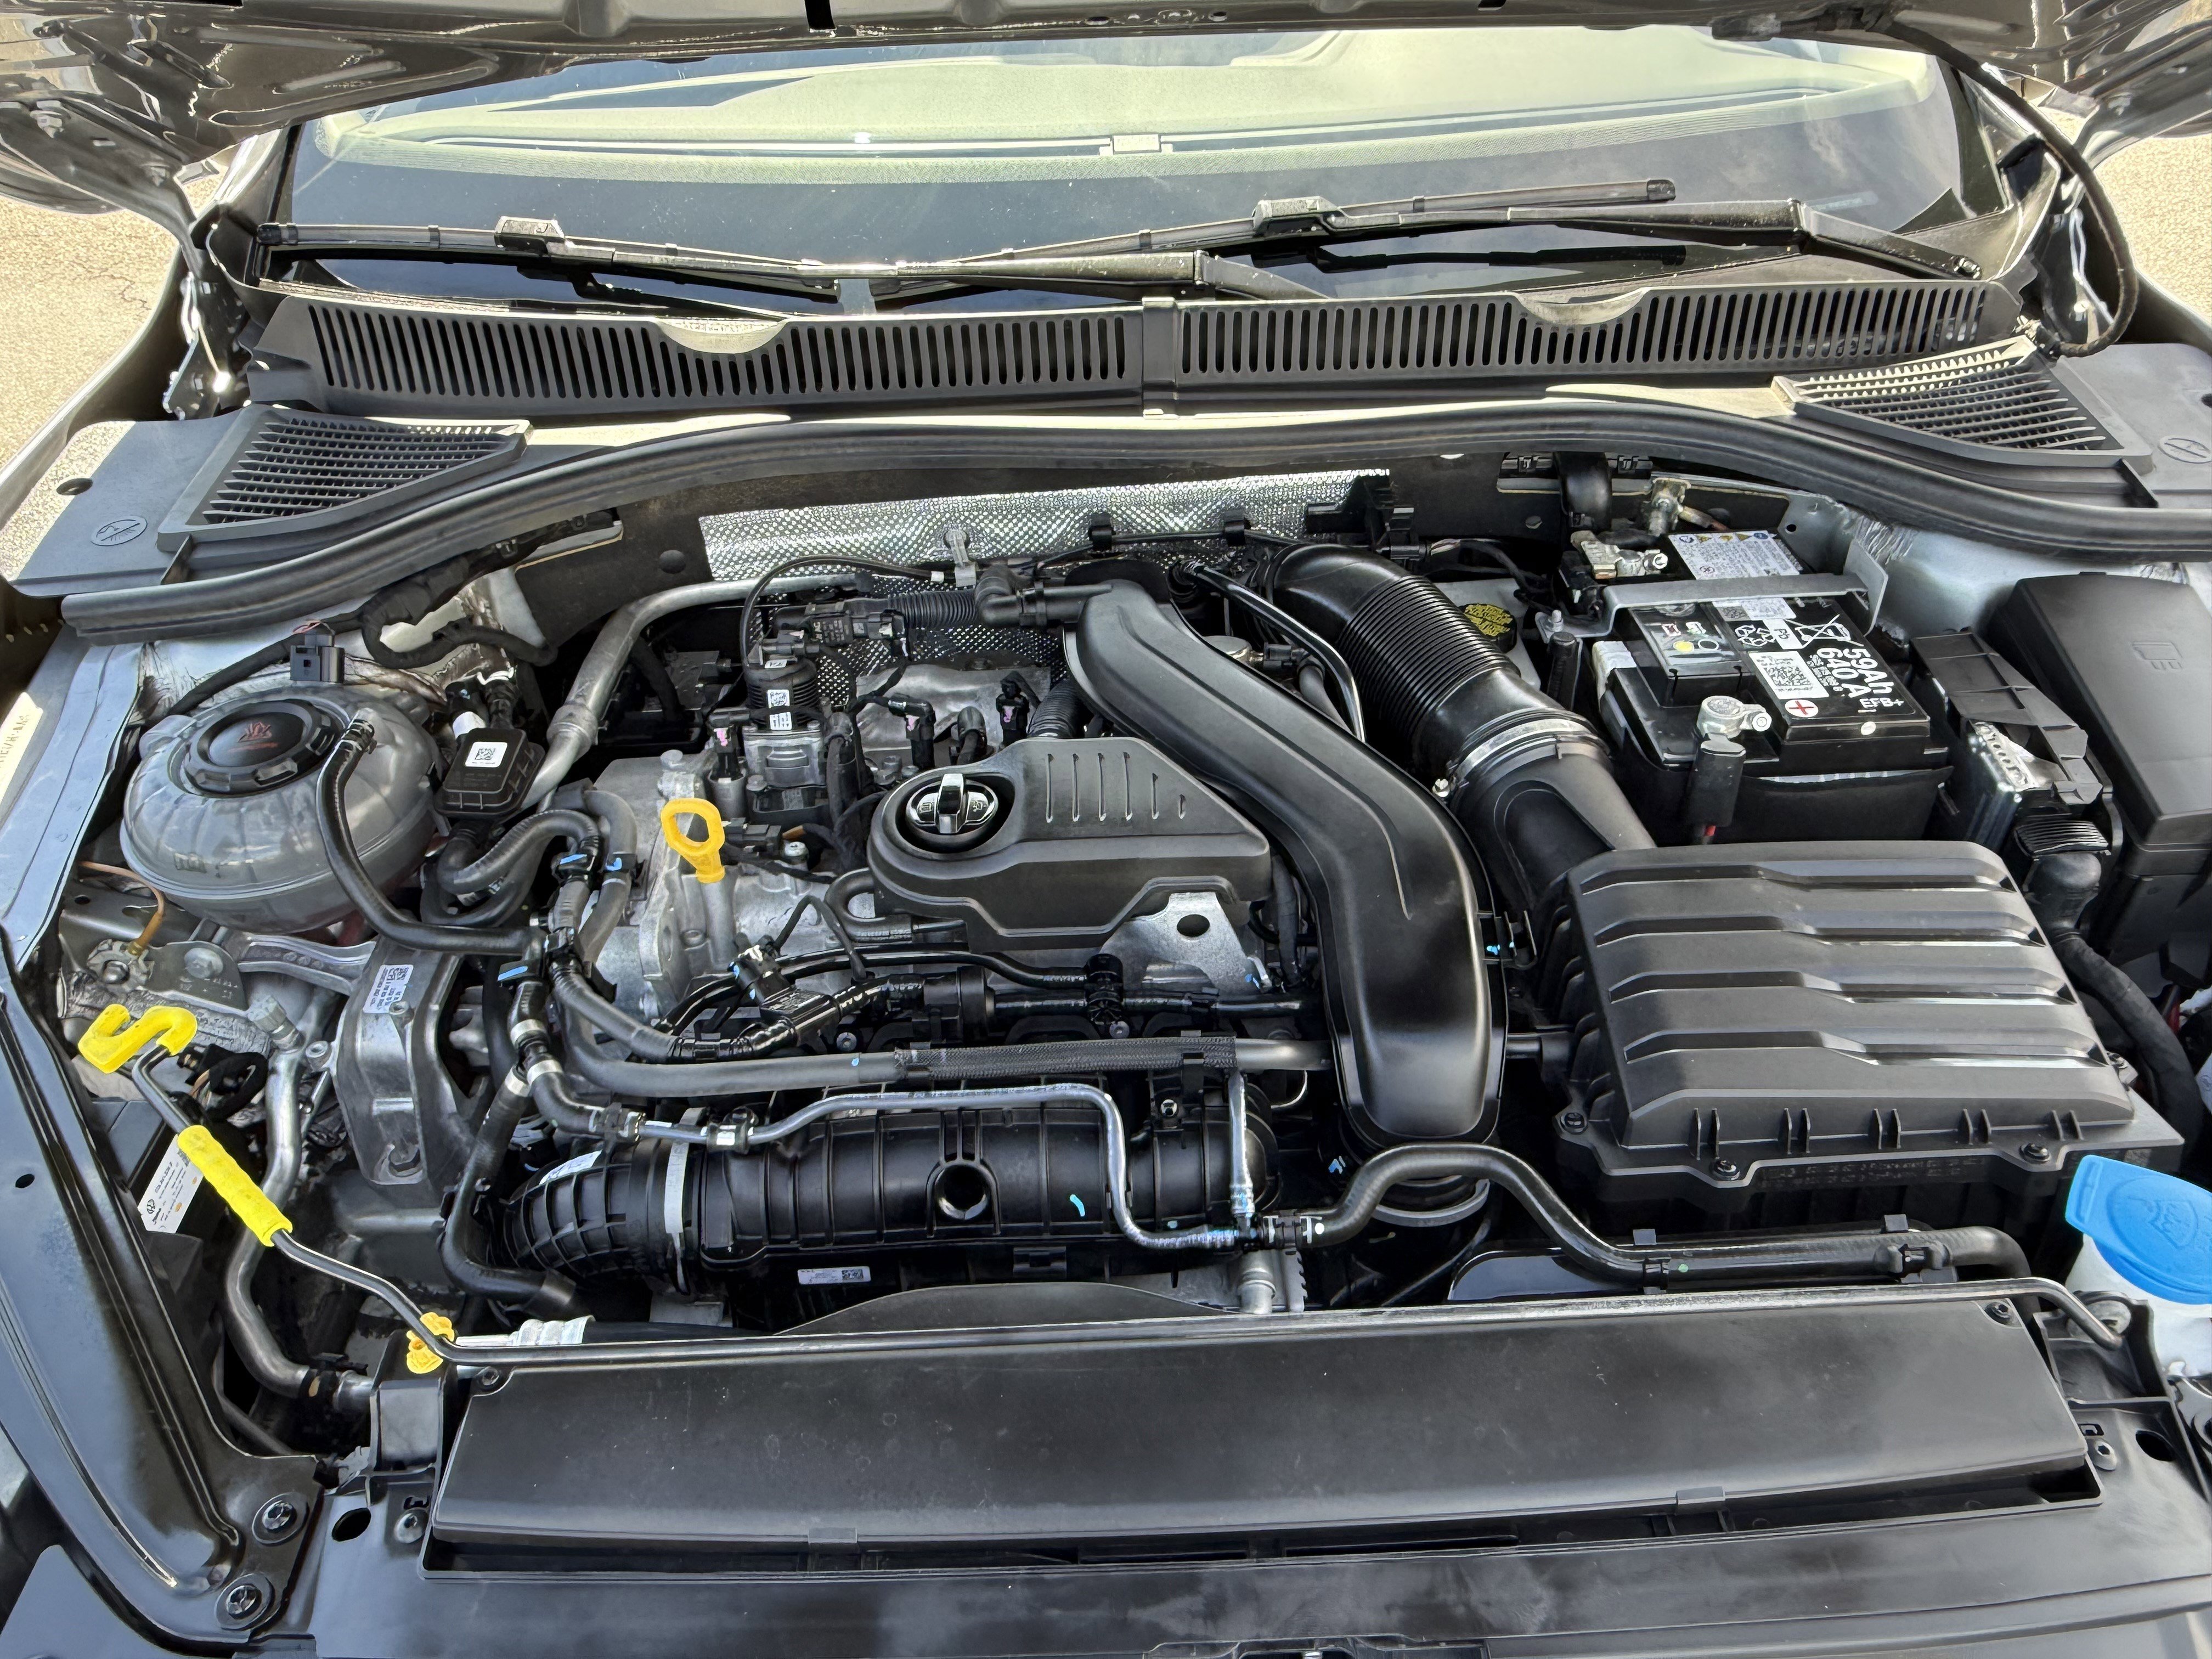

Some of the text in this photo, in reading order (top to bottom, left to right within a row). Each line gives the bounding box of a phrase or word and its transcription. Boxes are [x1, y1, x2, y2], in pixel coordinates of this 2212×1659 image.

[1774, 628, 1790, 639] Pb
[1816, 647, 1859, 679] 640
[1841, 683, 1872, 698] A
[1842, 648, 1894, 694] 59Ah
[1859, 697, 1904, 708] EFB+
